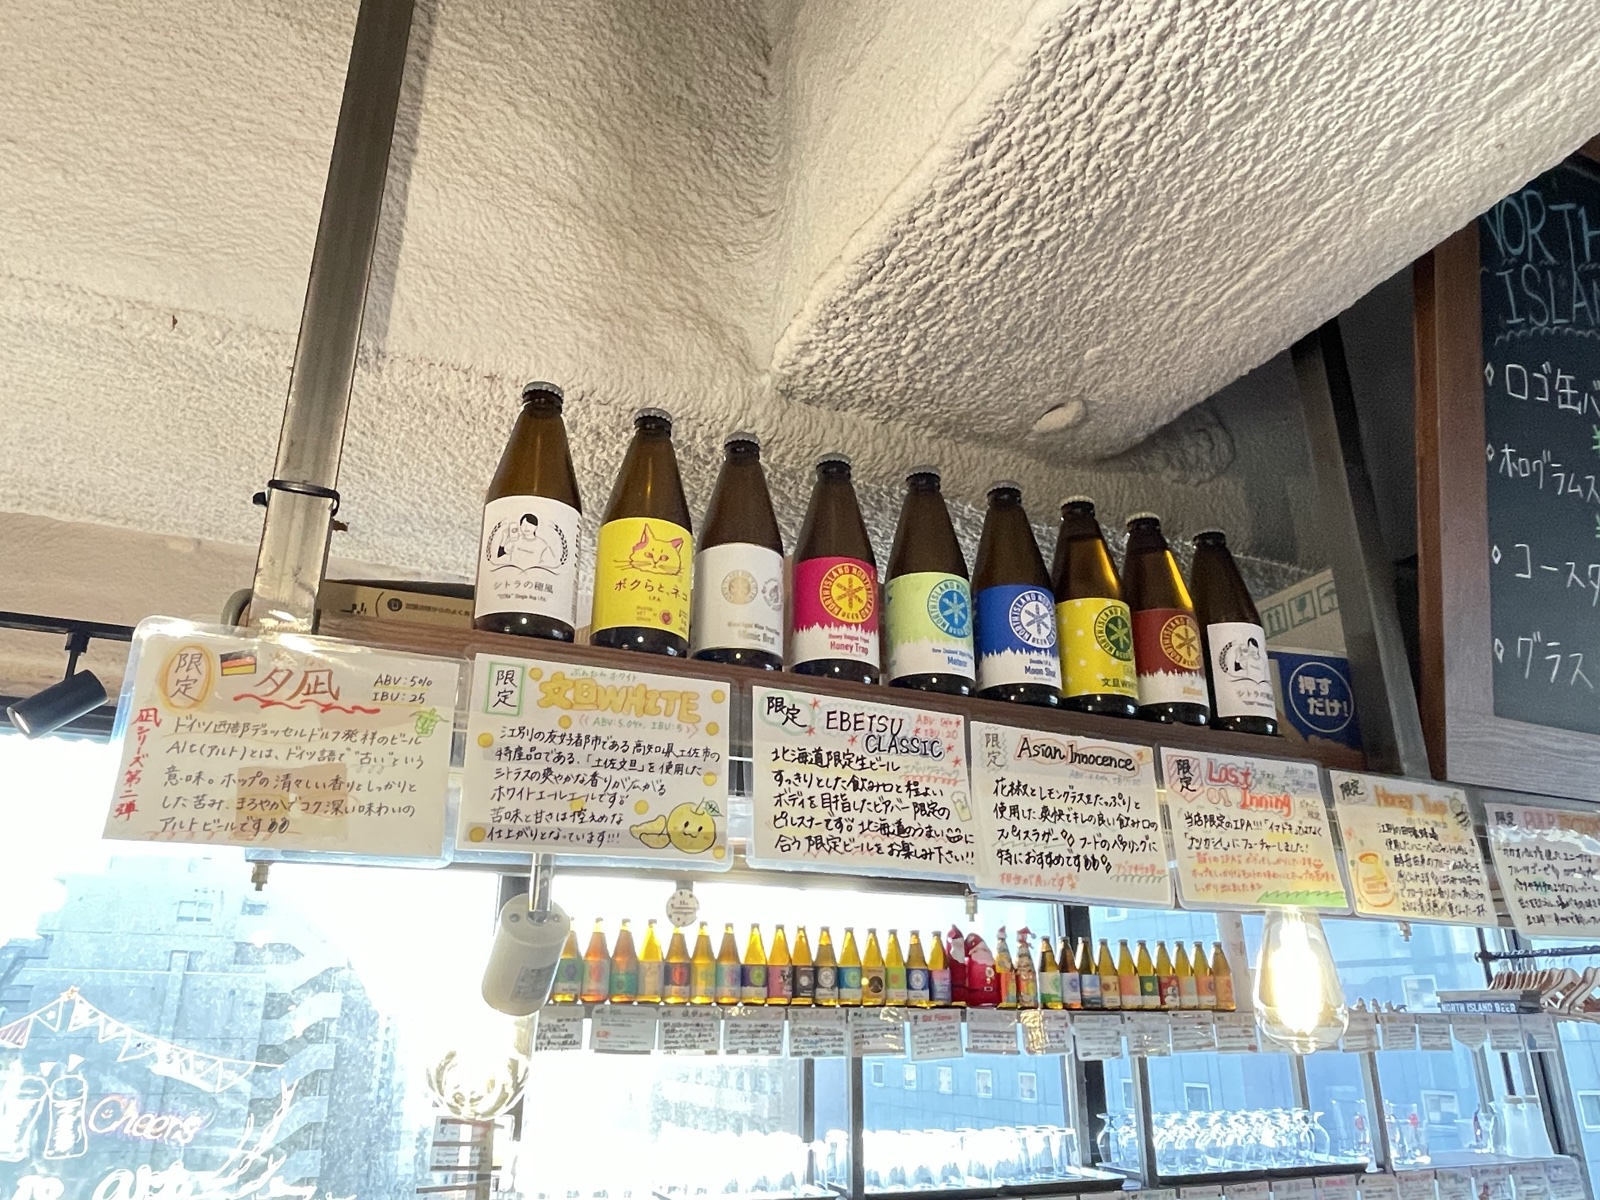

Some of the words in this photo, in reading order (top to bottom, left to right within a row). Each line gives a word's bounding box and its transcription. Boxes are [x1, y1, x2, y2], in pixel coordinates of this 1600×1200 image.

[614, 577, 688, 601] ボクらと、ネコ
[830, 641, 854, 653] Honey
[855, 643, 869, 656] Trap
[1516, 631, 1595, 689] グラス
[169, 652, 202, 701] 限定
[254, 667, 340, 701] 夕凪
[492, 669, 518, 708] 限定
[1298, 675, 1332, 696] 押す
[766, 696, 807, 728] 限定
[825, 709, 904, 736] EBETSU
[499, 724, 721, 763] 江別の友好都市である高知県土佐市の
[771, 746, 901, 772] 北海道限定生ビール
[864, 733, 943, 758] CLASSIC
[985, 732, 1005, 768] 限定
[1017, 737, 1066, 761] Asian
[1068, 744, 1135, 771] Innocence
[114, 707, 162, 821] 凪シリーズ第二弾
[1176, 758, 1197, 793] 限定
[1208, 760, 1252, 789] Lost
[494, 766, 667, 797] シトラスの爽やかな香りが広がる
[771, 769, 944, 799] すっきりとした飲み口と程よい
[993, 776, 1141, 814] 花椒とレモングラスをたっぷりと
[1339, 778, 1364, 800] 限定
[490, 807, 624, 825] 苦味と甘さは控えめな
[773, 787, 950, 820] ボディを目指したビアバー限定の
[993, 802, 1159, 831] 使用した爽快でキレの良い飲み口の
[1239, 788, 1292, 818] Inning
[1441, 1002, 1465, 1013] NORTH
[1467, 1002, 1493, 1013] ISLAND
[88, 1095, 203, 1144] Cheers
